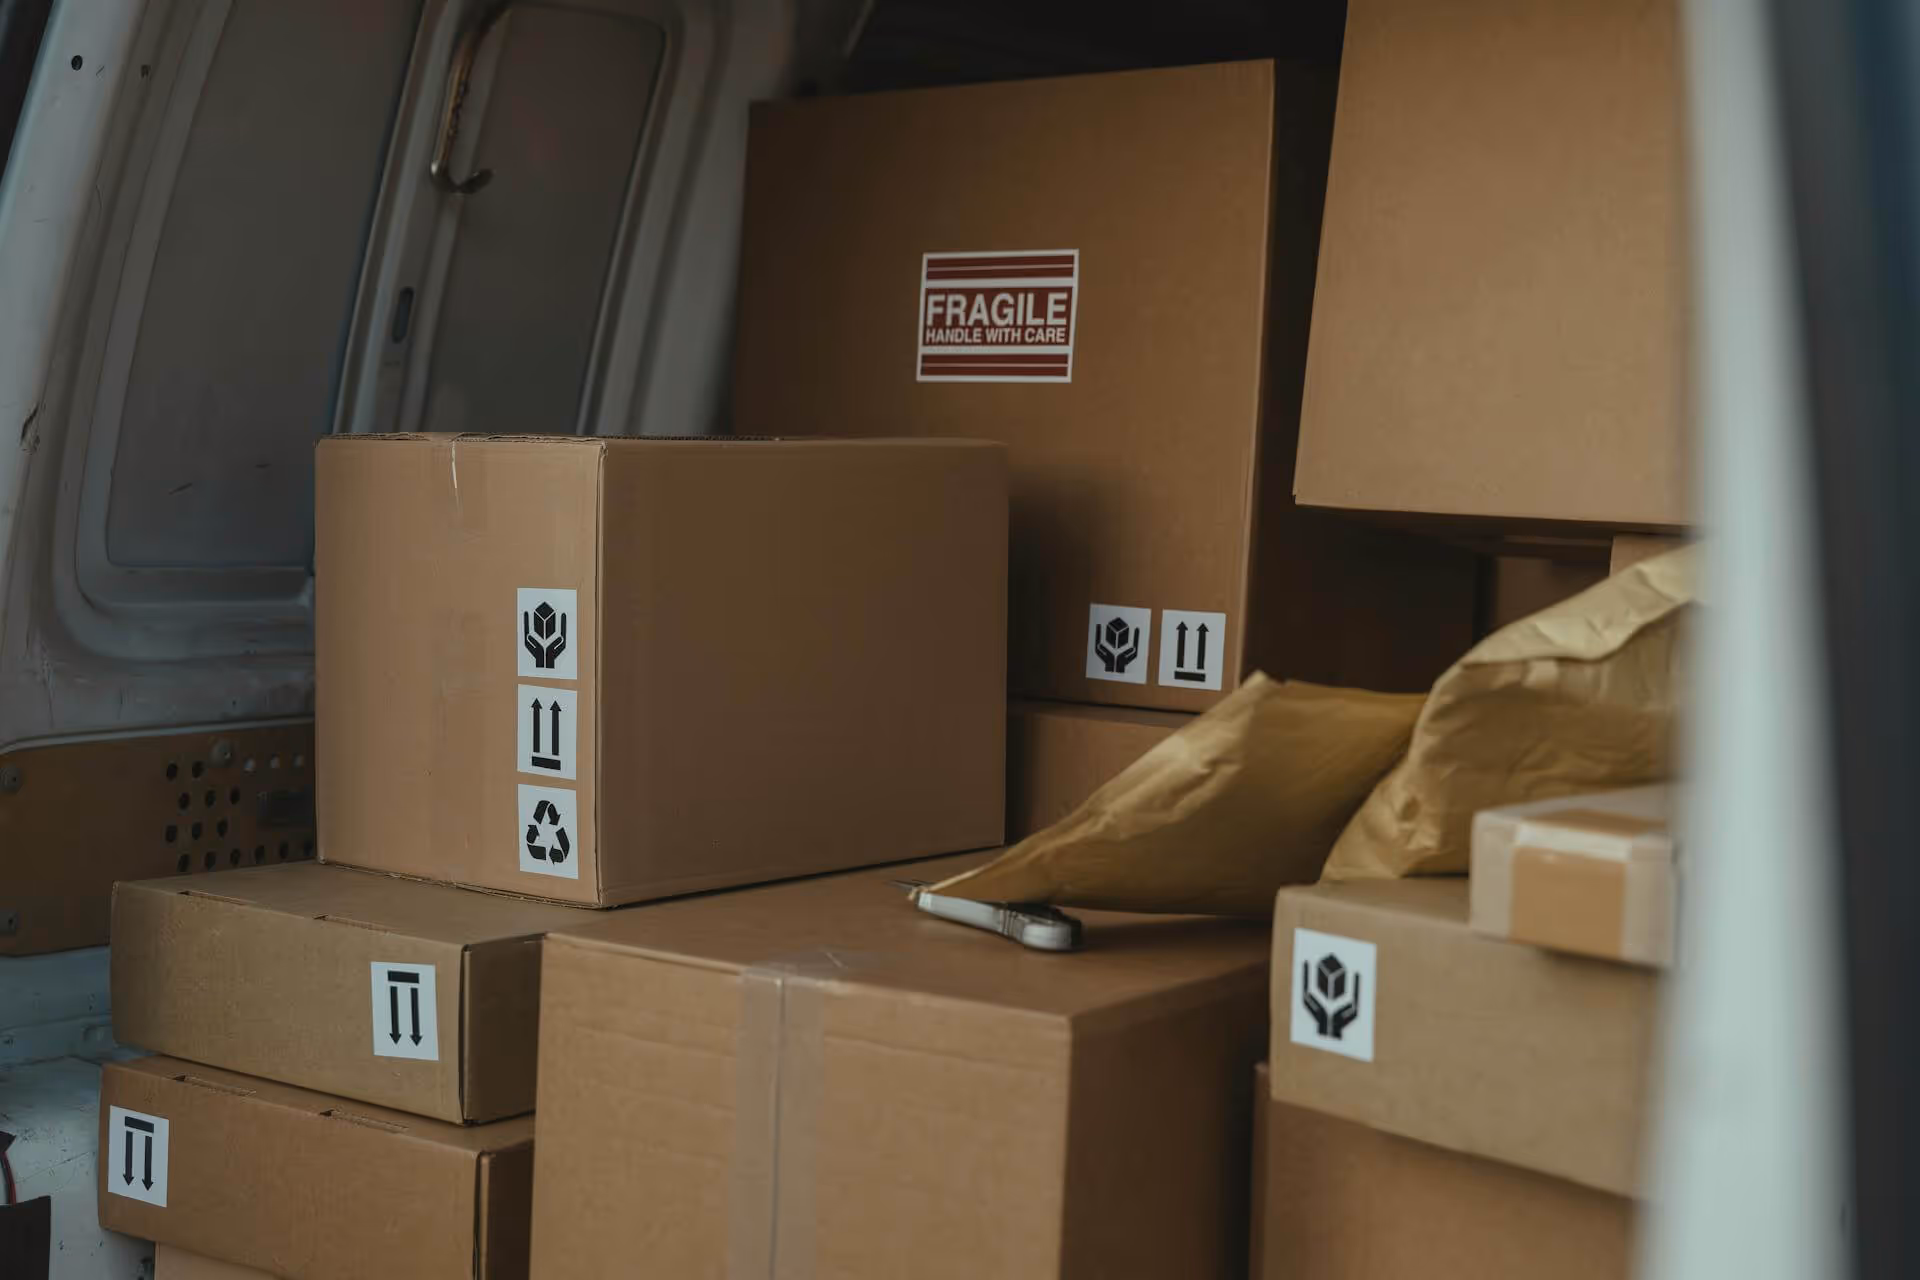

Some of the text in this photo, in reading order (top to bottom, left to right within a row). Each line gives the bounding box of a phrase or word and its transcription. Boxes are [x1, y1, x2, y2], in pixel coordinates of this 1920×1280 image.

[926, 292, 1068, 326] FRAGILE
[925, 327, 1066, 343] HANDLE WITH CARE
